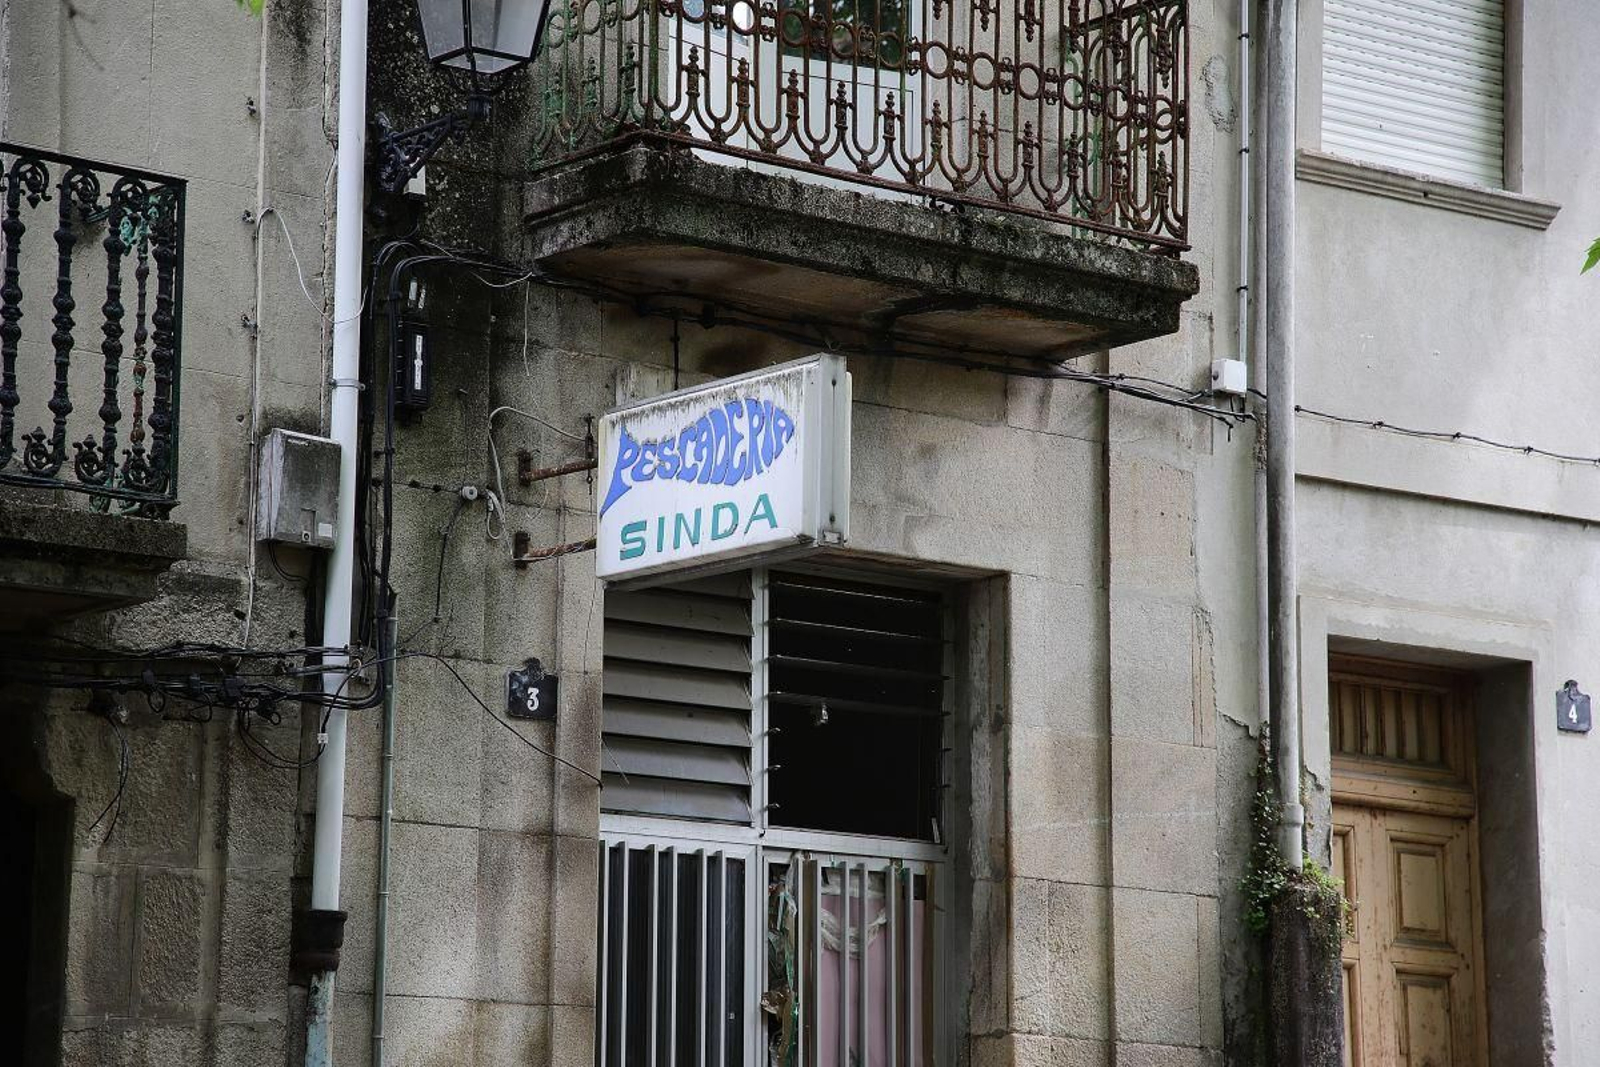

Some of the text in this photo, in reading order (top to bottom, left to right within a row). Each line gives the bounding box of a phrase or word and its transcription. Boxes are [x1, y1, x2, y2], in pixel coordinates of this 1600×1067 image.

[600, 398, 795, 523] PESCADERIA
[619, 493, 778, 561] SINDA
[527, 687, 540, 712] 3
[1568, 703, 1578, 724] 4
